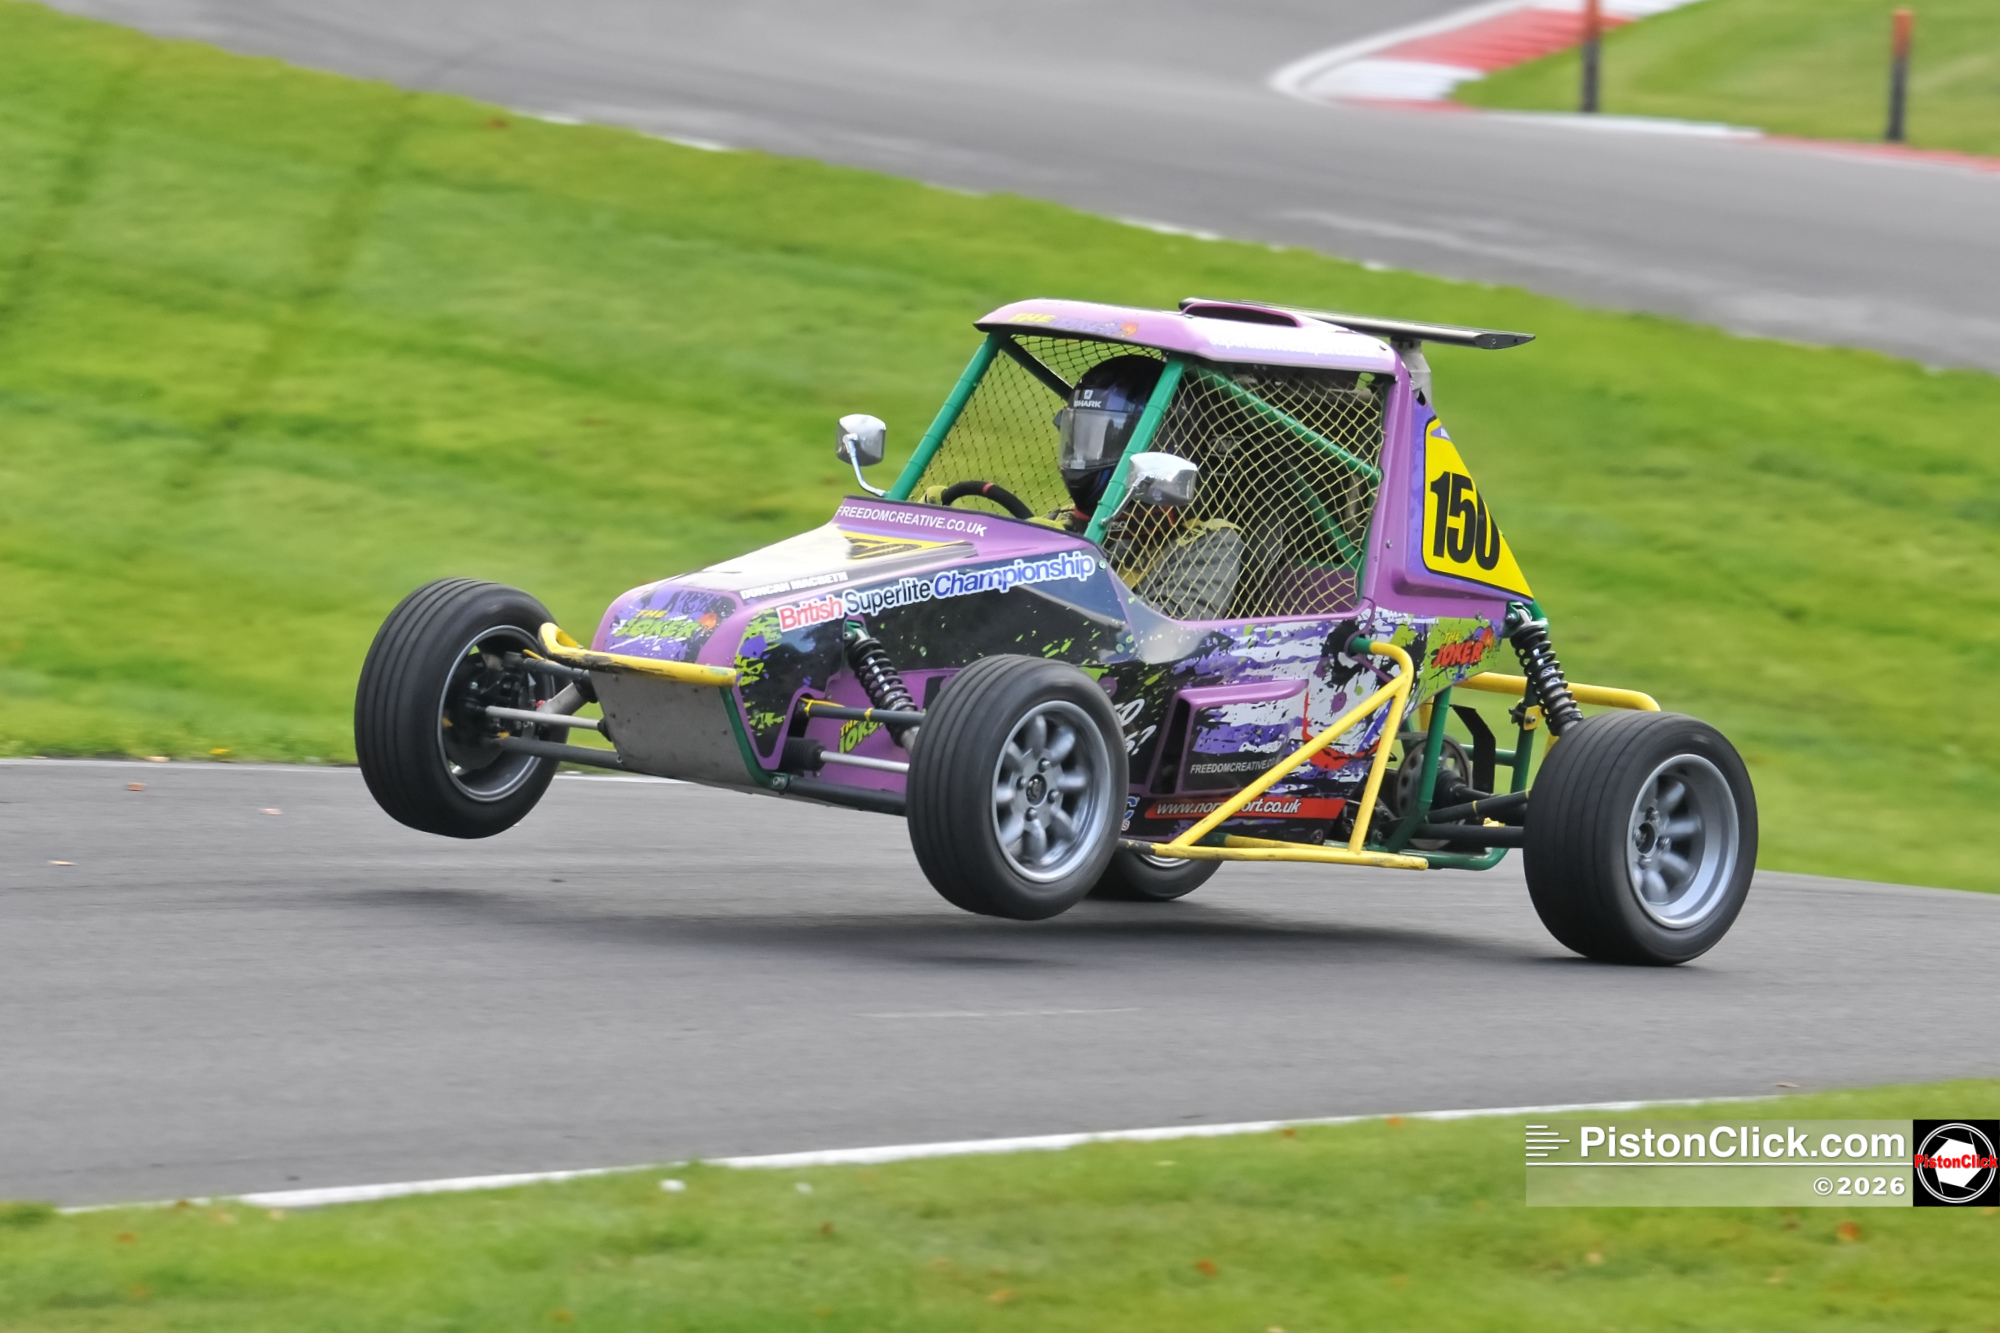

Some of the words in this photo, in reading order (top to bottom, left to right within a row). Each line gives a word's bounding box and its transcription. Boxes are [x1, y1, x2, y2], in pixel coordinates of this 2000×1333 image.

[1074, 400, 1102, 408] SHARK
[836, 505, 988, 538] FREEDOMCREATIVE.CO.UK
[1430, 471, 1501, 571] 150
[740, 581, 790, 600] DUNCAN
[789, 571, 849, 590] MACBETH
[779, 596, 843, 631] British
[844, 579, 931, 614] Superlite
[934, 551, 1094, 598] Championship
[613, 617, 701, 638] JOKER
[635, 609, 668, 619] THE
[1444, 631, 1461, 643] THE
[1431, 640, 1485, 669] JOKER
